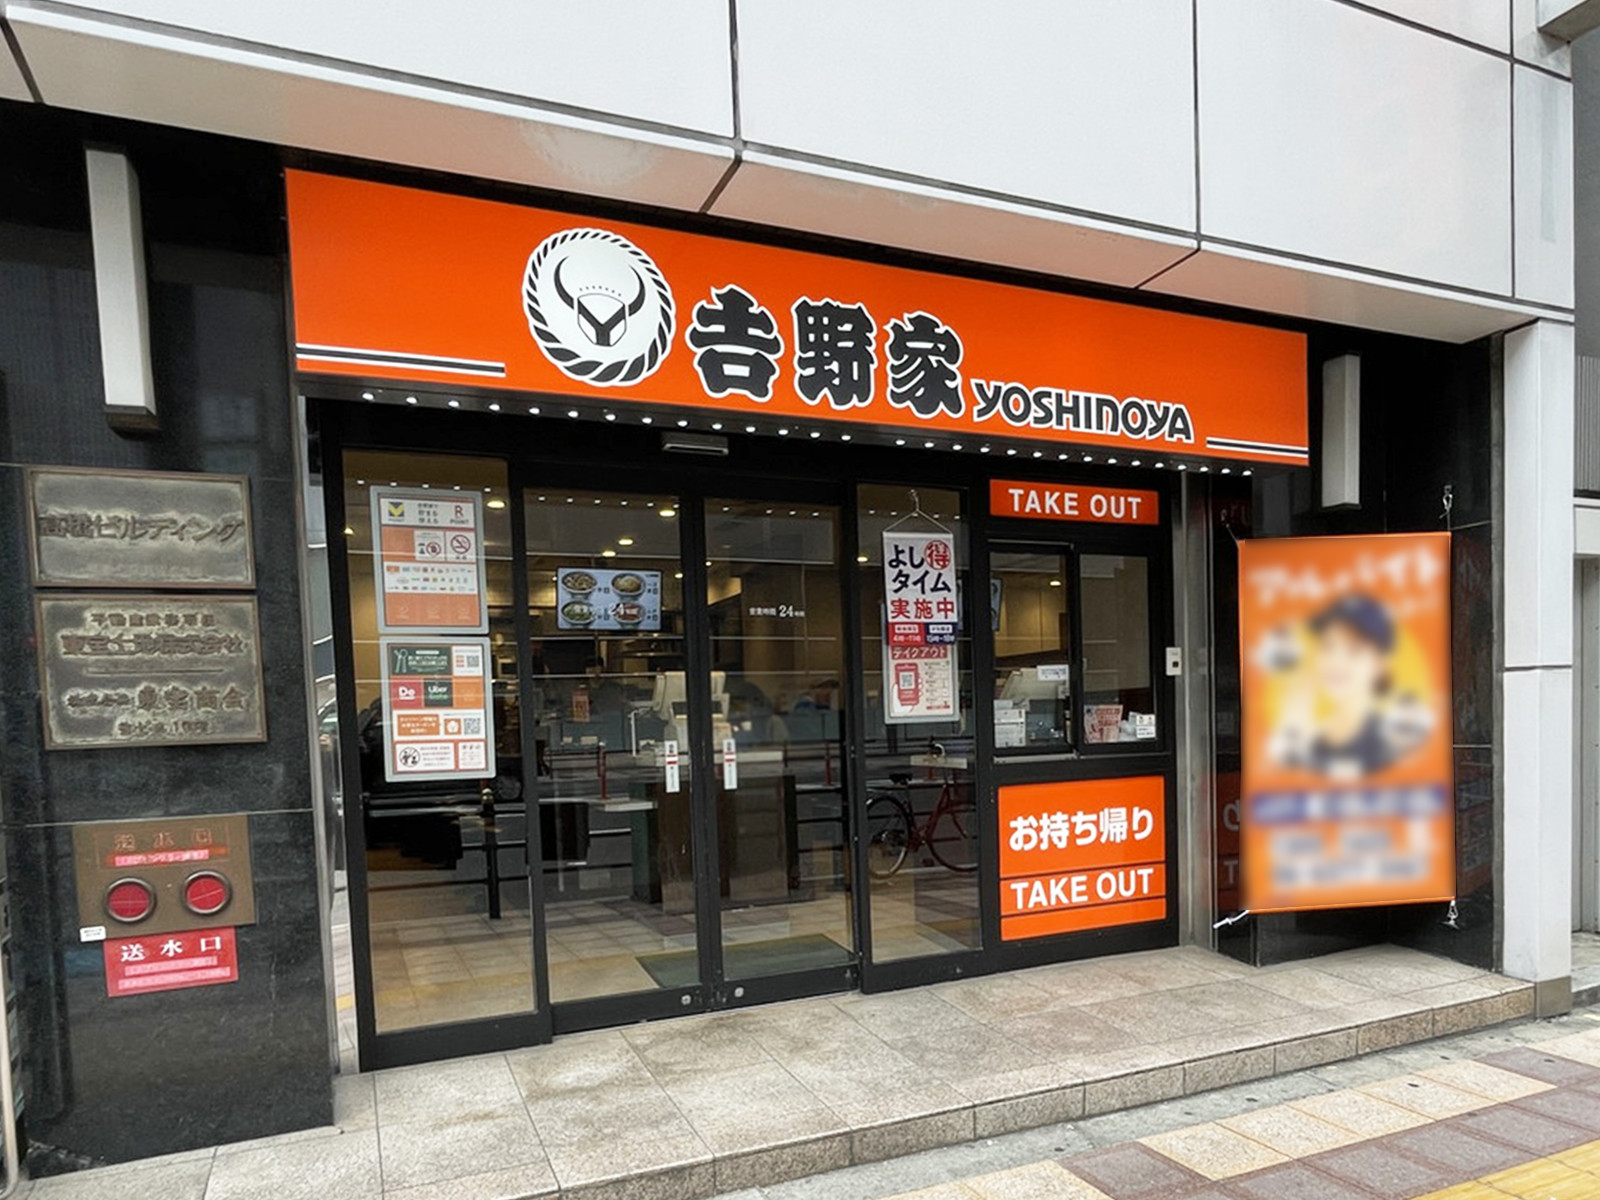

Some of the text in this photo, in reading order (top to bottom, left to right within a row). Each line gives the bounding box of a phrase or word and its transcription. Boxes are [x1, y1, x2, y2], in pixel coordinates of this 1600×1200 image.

[686, 284, 965, 419] 吉野家
[971, 379, 1195, 443] YOSHINOYA
[1008, 488, 1142, 520] TAKE OUT
[892, 569, 951, 595] タイム
[890, 597, 955, 619] 実施中
[1008, 806, 1154, 851] お持ち帰り
[1010, 868, 1154, 910] TAKE OUT
[120, 936, 222, 962] 送水口
